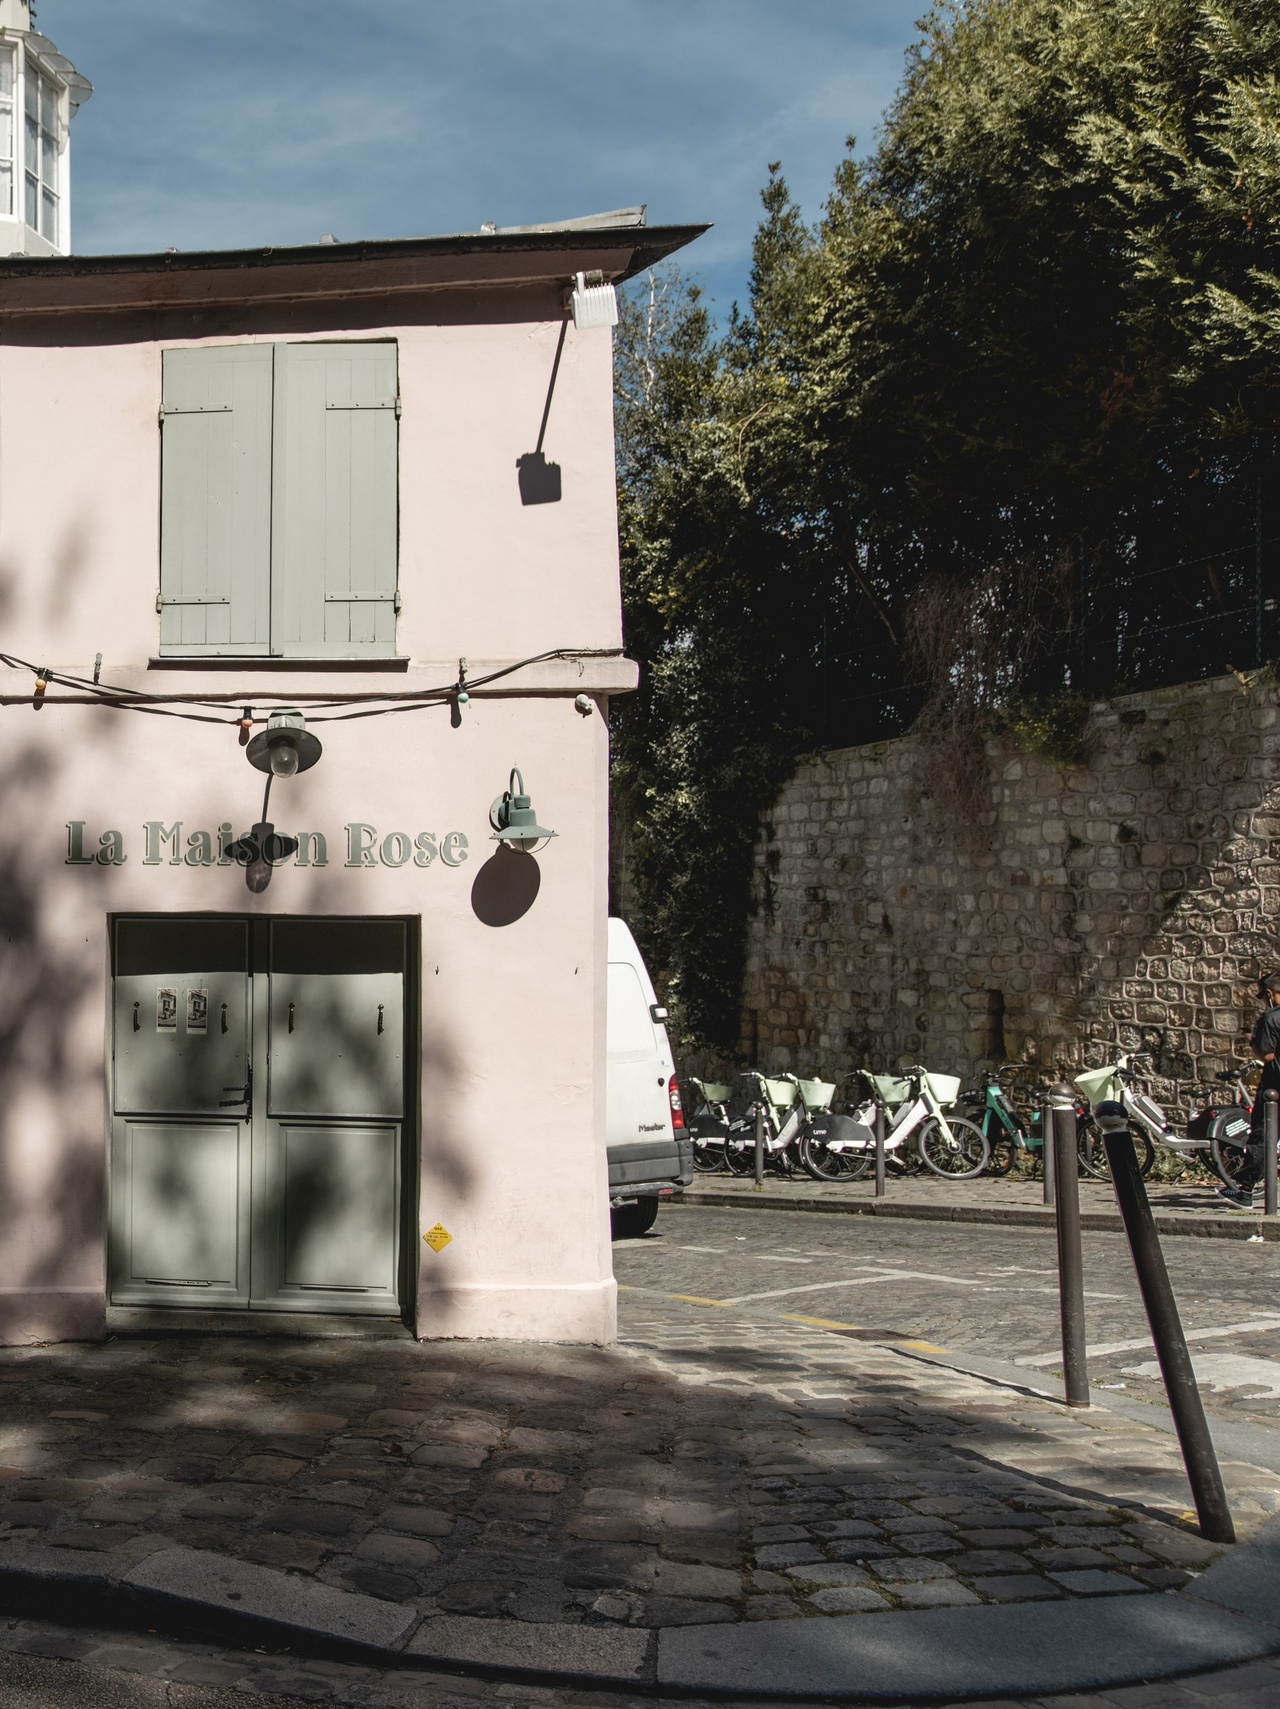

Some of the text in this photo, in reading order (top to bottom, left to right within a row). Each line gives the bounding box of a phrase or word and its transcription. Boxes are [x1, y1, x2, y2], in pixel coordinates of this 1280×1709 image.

[66, 820, 470, 868] La Maison Rose
